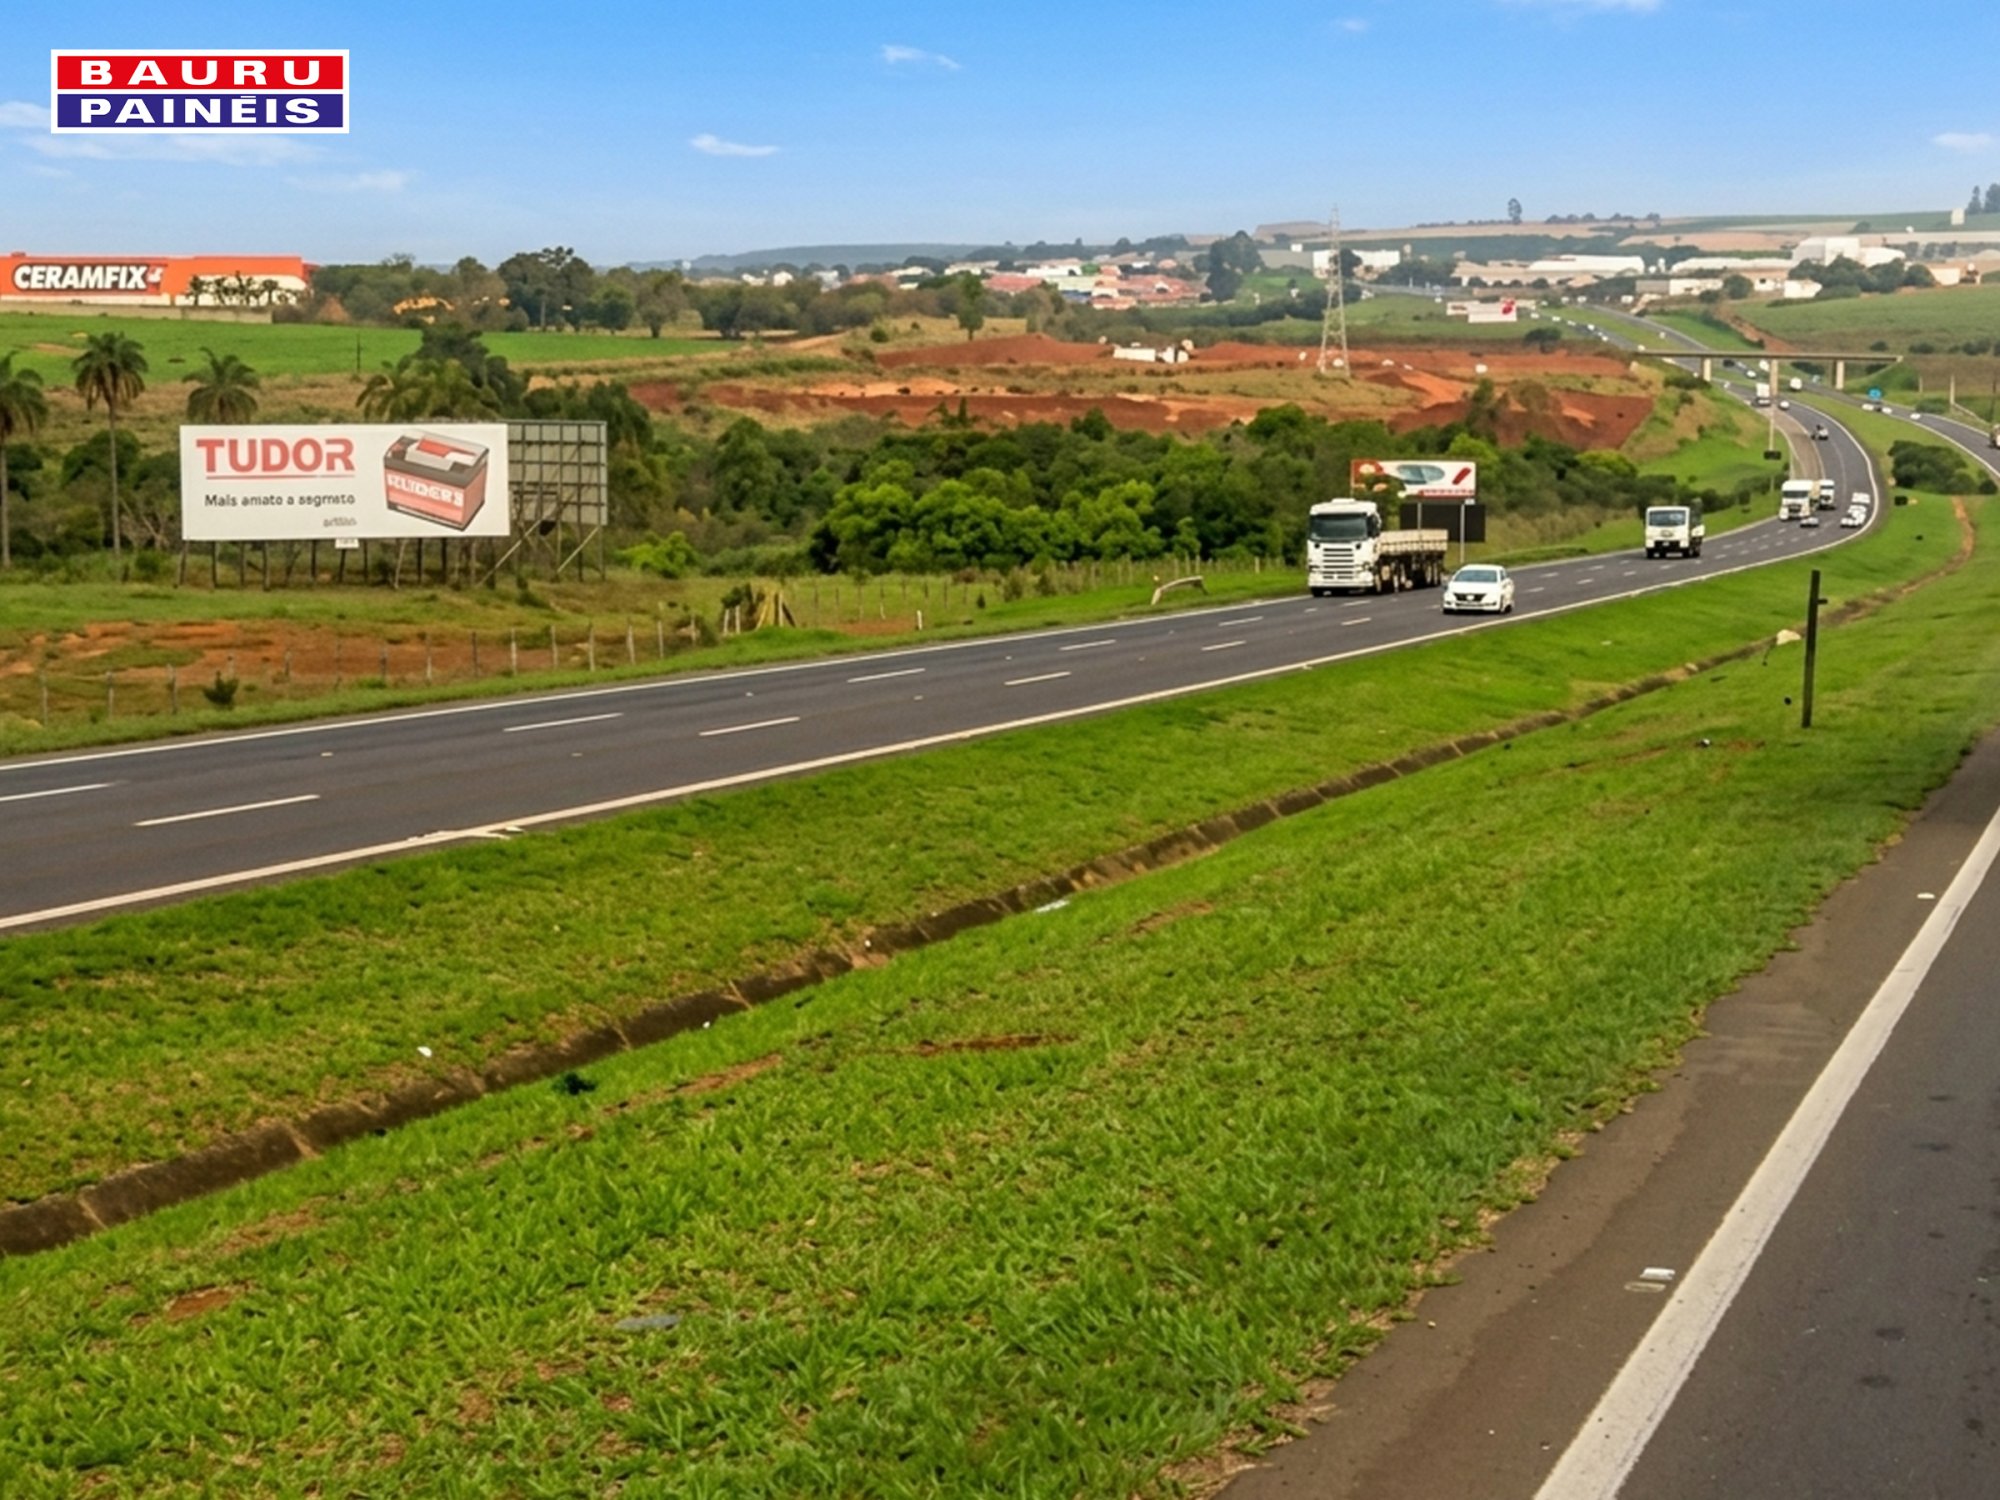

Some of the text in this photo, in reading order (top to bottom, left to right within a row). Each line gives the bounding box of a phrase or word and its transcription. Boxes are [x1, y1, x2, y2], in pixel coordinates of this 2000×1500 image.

[14, 265, 148, 289] CERAMFIX
[196, 438, 355, 473] TUDOR
[204, 494, 238, 507] Mais
